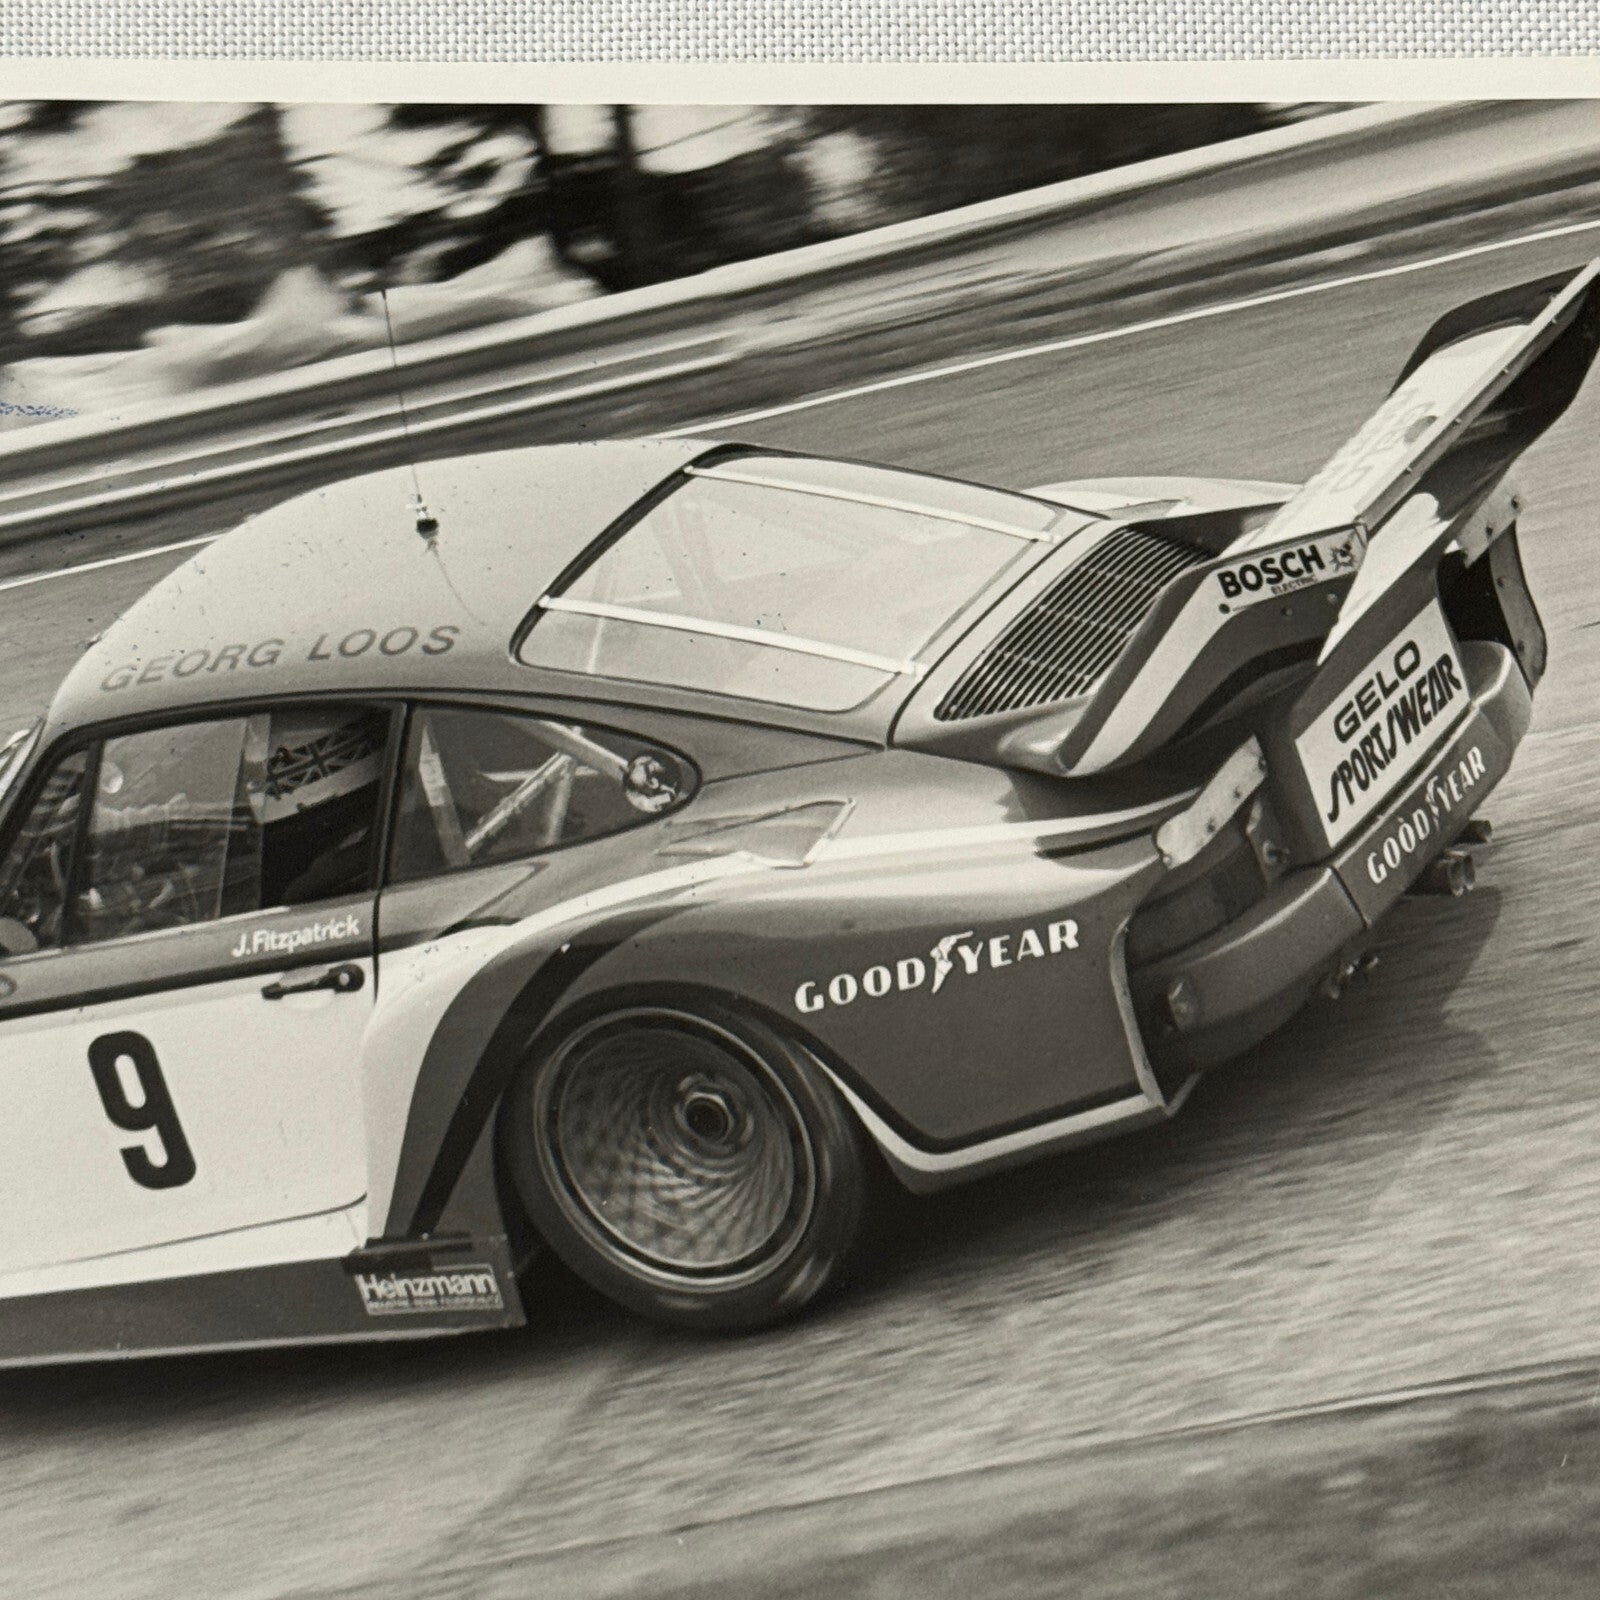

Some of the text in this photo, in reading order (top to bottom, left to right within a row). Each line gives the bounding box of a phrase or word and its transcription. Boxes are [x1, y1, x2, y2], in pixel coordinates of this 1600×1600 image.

[1217, 544, 1325, 599] BOSCH
[101, 626, 461, 692] GEORG LOOS
[1333, 640, 1421, 744] GELO
[1327, 653, 1462, 823] SPORTSWEAR
[1367, 746, 1487, 884] GOODYEAR
[795, 919, 1079, 1013] GOODYEAR
[87, 1030, 197, 1190] 9
[354, 1272, 498, 1301] Heinzmann
